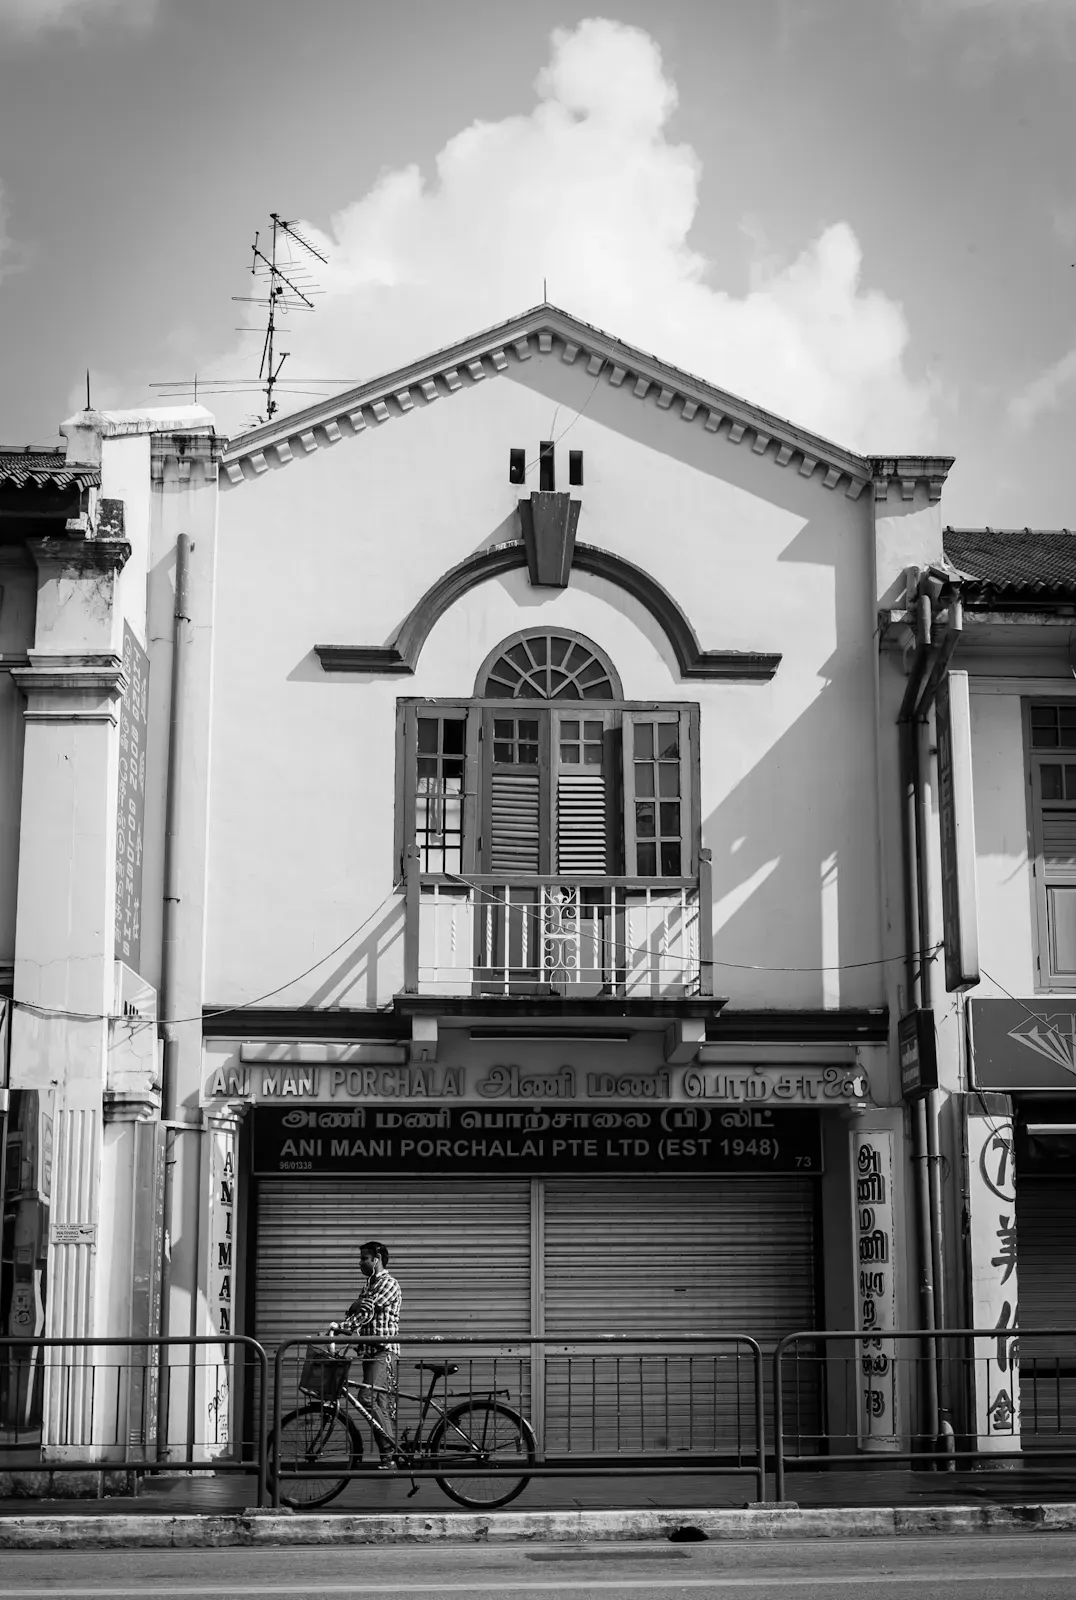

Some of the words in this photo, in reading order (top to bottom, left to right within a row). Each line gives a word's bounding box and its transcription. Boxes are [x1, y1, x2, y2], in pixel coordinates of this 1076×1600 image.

[132, 646, 141, 722] THONG
[129, 725, 139, 791] SOON
[939, 730, 957, 957] MERLIN
[122, 797, 136, 957] GOLDSMITHS
[211, 1067, 251, 1097] ANI
[262, 1067, 320, 1097] MANI
[331, 1066, 466, 1098] PORCHALAI
[476, 1065, 576, 1099] அணி
[587, 1065, 673, 1099] மணி
[281, 1106, 366, 1129] அணி
[375, 1106, 451, 1129] மணி
[279, 1139, 323, 1157] ANI
[330, 1139, 392, 1157] MANI
[400, 1138, 545, 1157] PORCHALAI
[552, 1139, 598, 1157] PTE
[606, 1139, 650, 1157] LTD
[658, 1138, 712, 1160] (EST
[720, 1138, 780, 1160] 1948)
[279, 1161, 313, 1170] 96/01338
[794, 1156, 812, 1167] 73
